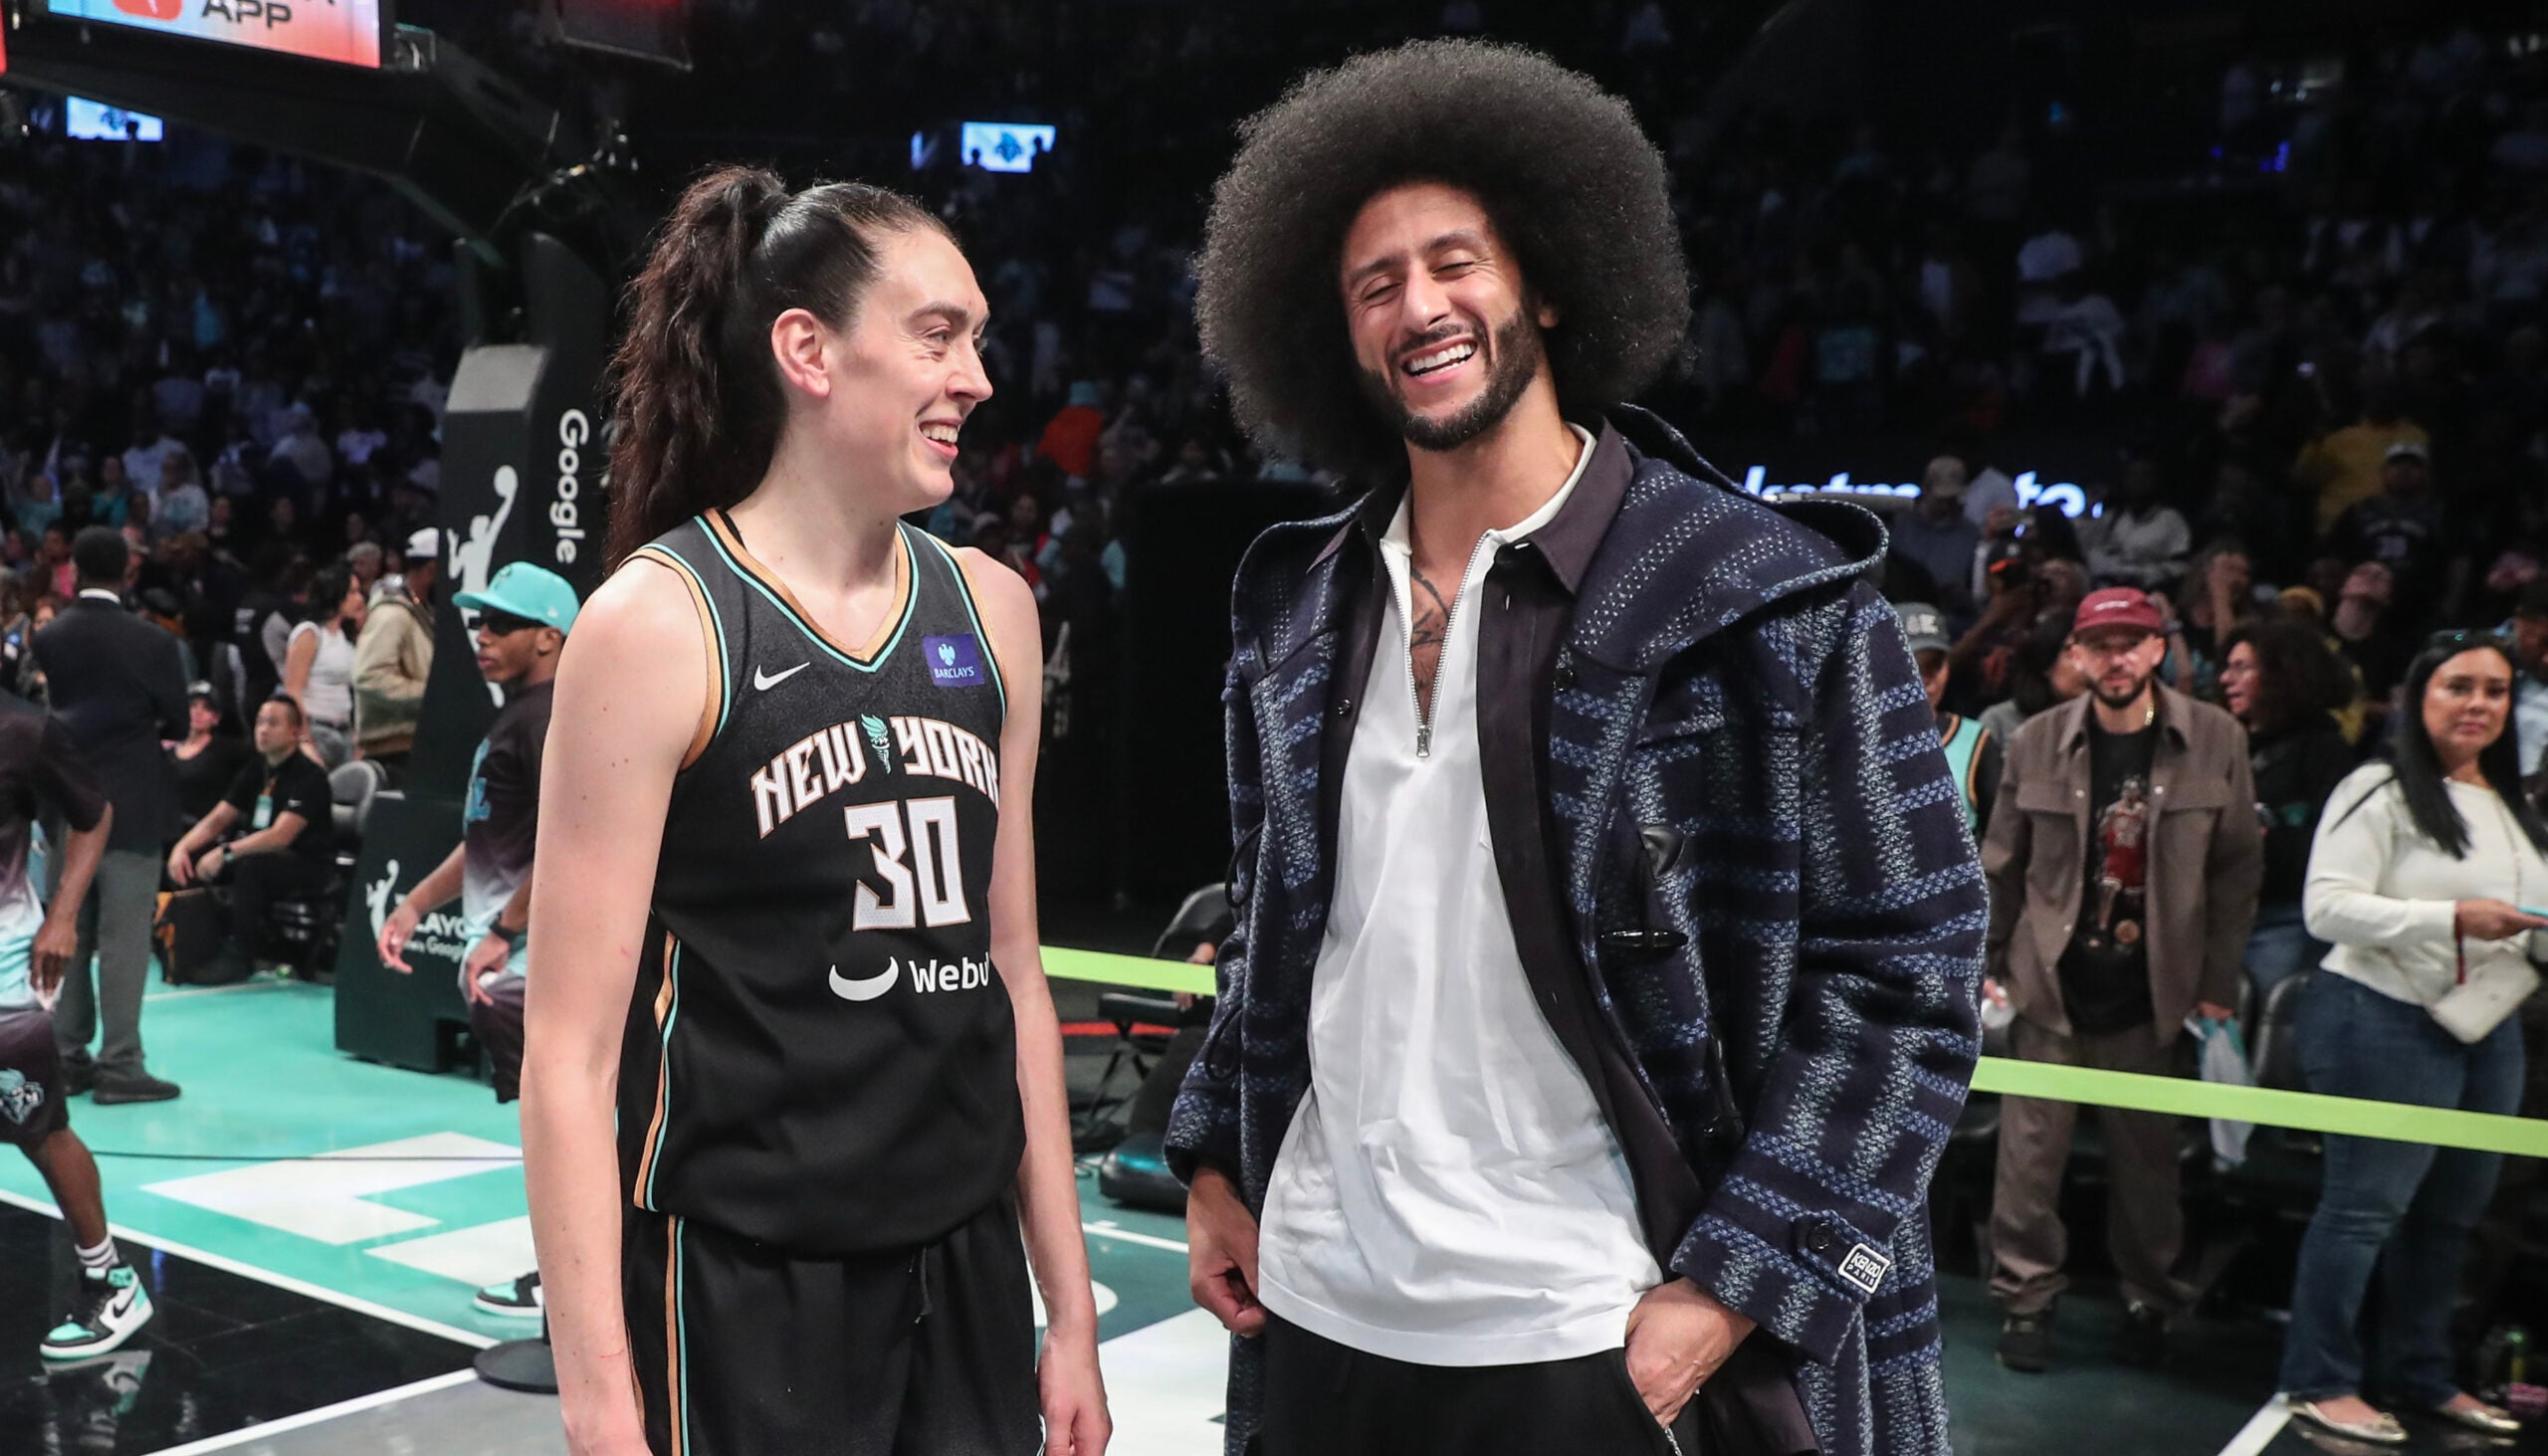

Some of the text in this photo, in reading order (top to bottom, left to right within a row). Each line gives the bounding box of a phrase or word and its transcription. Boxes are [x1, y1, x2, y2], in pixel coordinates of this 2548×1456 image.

[202, 0, 292, 29] APP
[549, 409, 589, 564] Google
[934, 666, 975, 679] BARCLAYS
[750, 721, 866, 839] NEW
[844, 795, 971, 932] 30
[1846, 1264, 1875, 1286] PARIS
